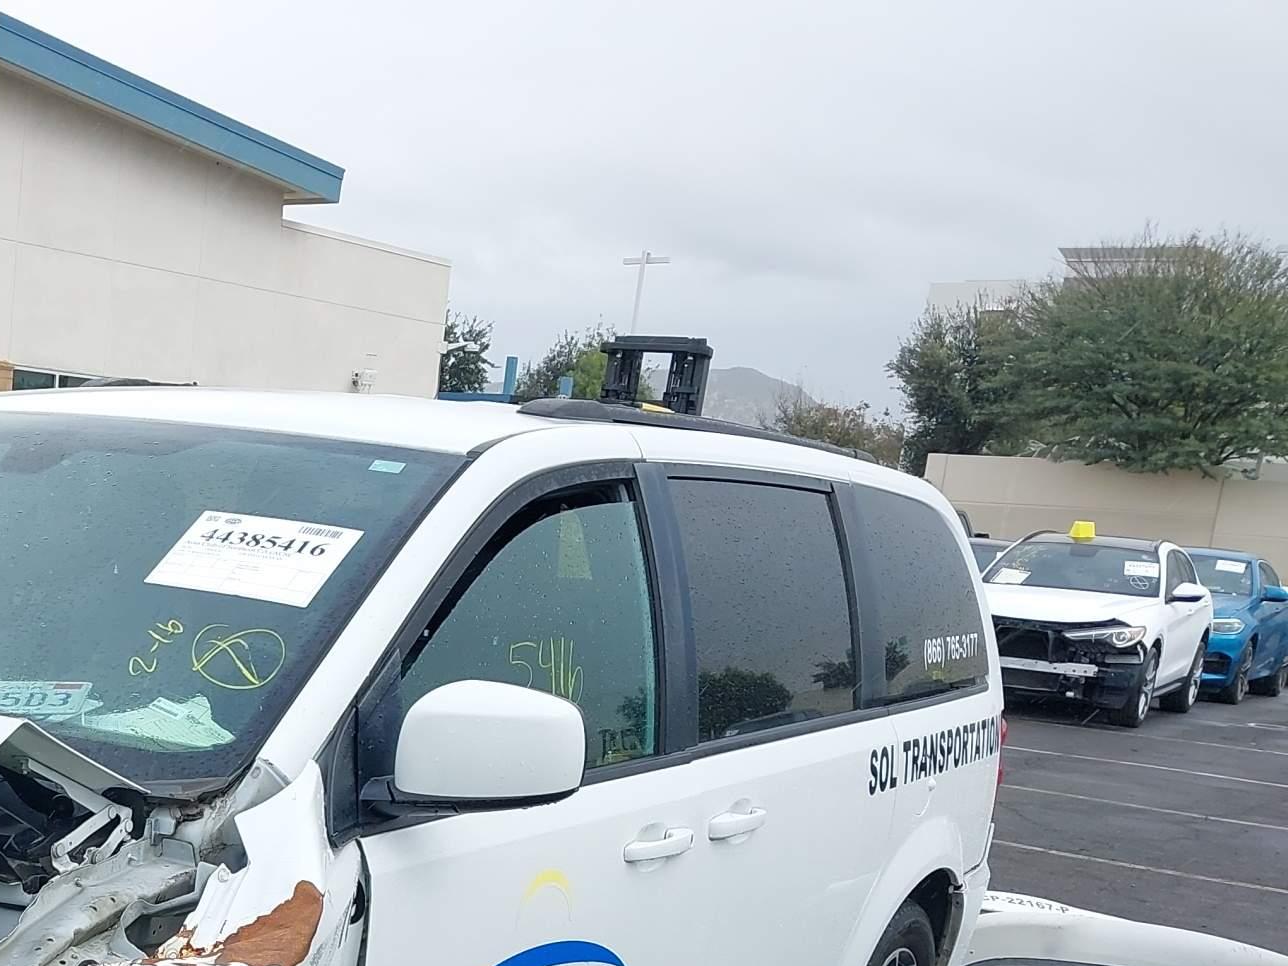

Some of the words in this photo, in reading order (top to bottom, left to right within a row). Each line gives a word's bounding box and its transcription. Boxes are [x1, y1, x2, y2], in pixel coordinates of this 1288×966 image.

[199, 528, 332, 557] 44385416
[128, 619, 184, 676] 2-16
[509, 637, 584, 705] 5416
[923, 638, 946, 671] (866)
[946, 633, 979, 662] 765-3177
[868, 744, 898, 796] SOL
[903, 713, 1001, 785] TRANSPORTATION
